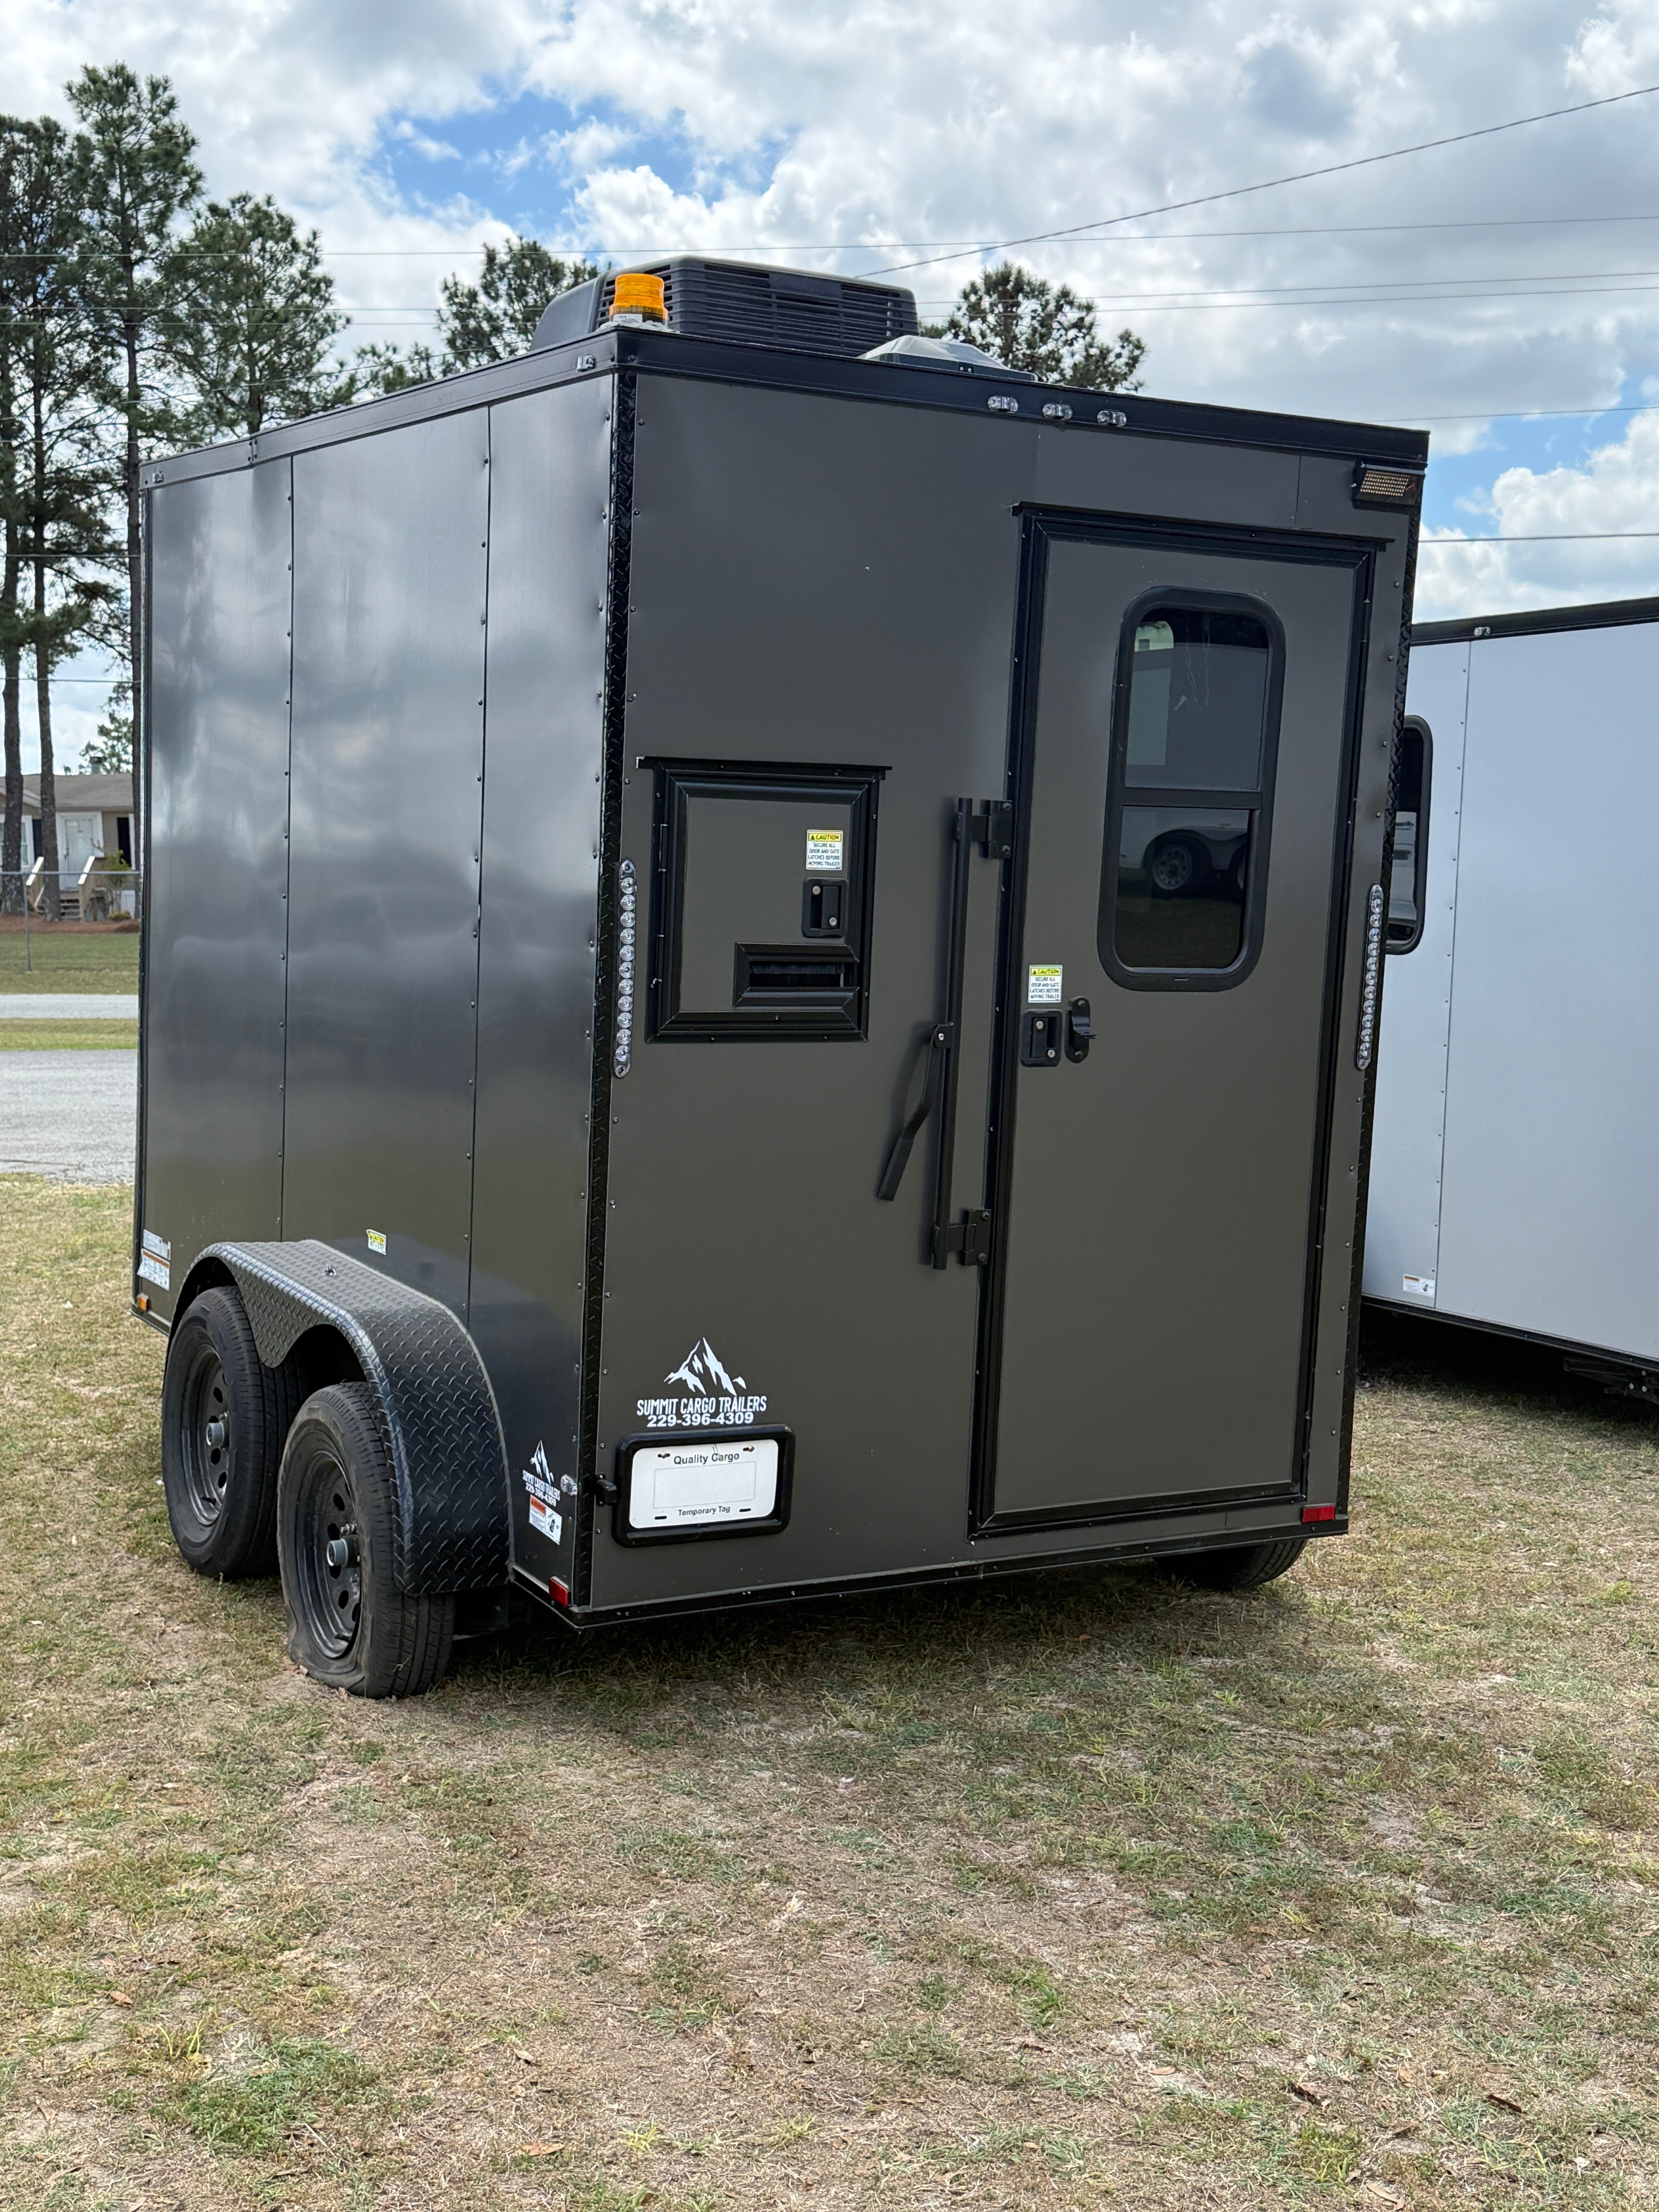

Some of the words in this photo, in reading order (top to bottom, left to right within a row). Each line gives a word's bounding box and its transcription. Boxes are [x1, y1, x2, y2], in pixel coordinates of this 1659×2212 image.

[636, 1398, 678, 1416] SUMMIT
[680, 1397, 716, 1414] CARGO
[718, 1396, 767, 1413] TRAILERS
[647, 1411, 754, 1427] 229-396-4309
[674, 1454, 708, 1465] Quality
[712, 1453, 740, 1462] Cargo
[677, 1507, 717, 1516] Temporary
